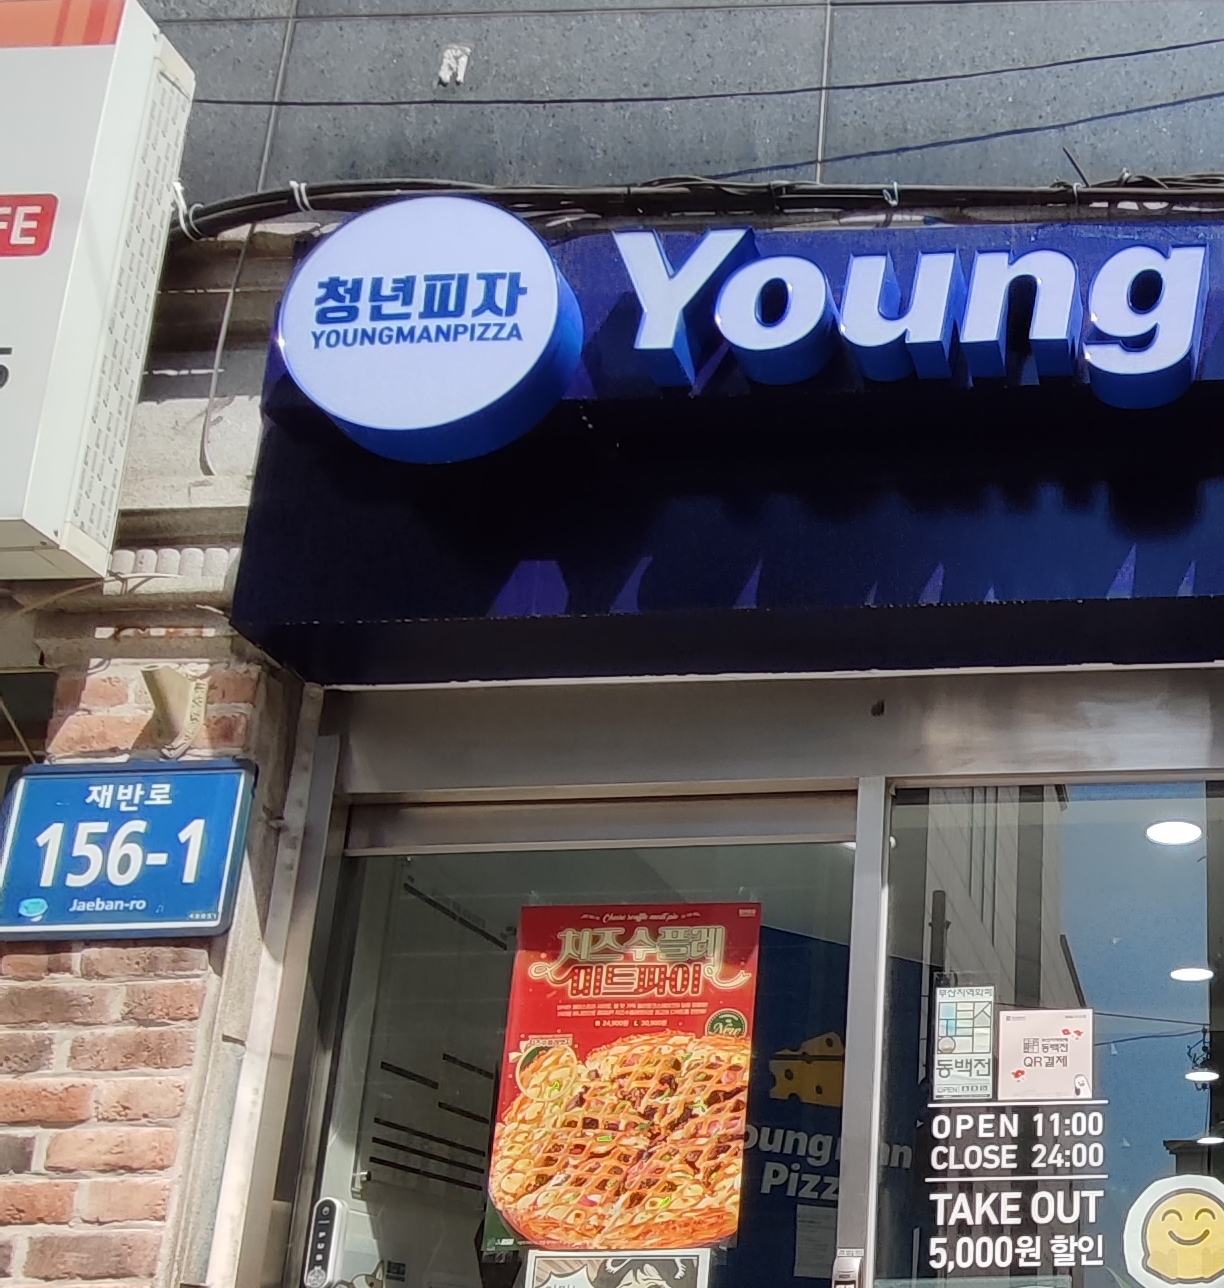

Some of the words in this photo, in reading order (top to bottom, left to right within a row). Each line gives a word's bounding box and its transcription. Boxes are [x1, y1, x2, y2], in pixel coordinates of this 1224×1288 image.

[315, 271, 528, 325] 청년피자
[311, 322, 523, 349] YOUNGMANPIZZA
[85, 783, 173, 812] 재반로
[35, 819, 206, 887] 156-1
[69, 897, 147, 912] Jaeban-ro
[1042, 1043, 1068, 1053] 동백전
[936, 1058, 991, 1079] 동백전
[931, 1113, 1019, 1139] OPEN
[1033, 1111, 1104, 1137] 11:00
[930, 1145, 1018, 1169] CLOSE
[1031, 1142, 1104, 1168] 24:00
[760, 1161, 839, 1200] Pizz
[929, 1191, 1022, 1226] TAKE
[1031, 1189, 1105, 1225] OUT
[929, 1235, 1041, 1273] 5,000원
[1050, 1234, 1104, 1267] 할인
